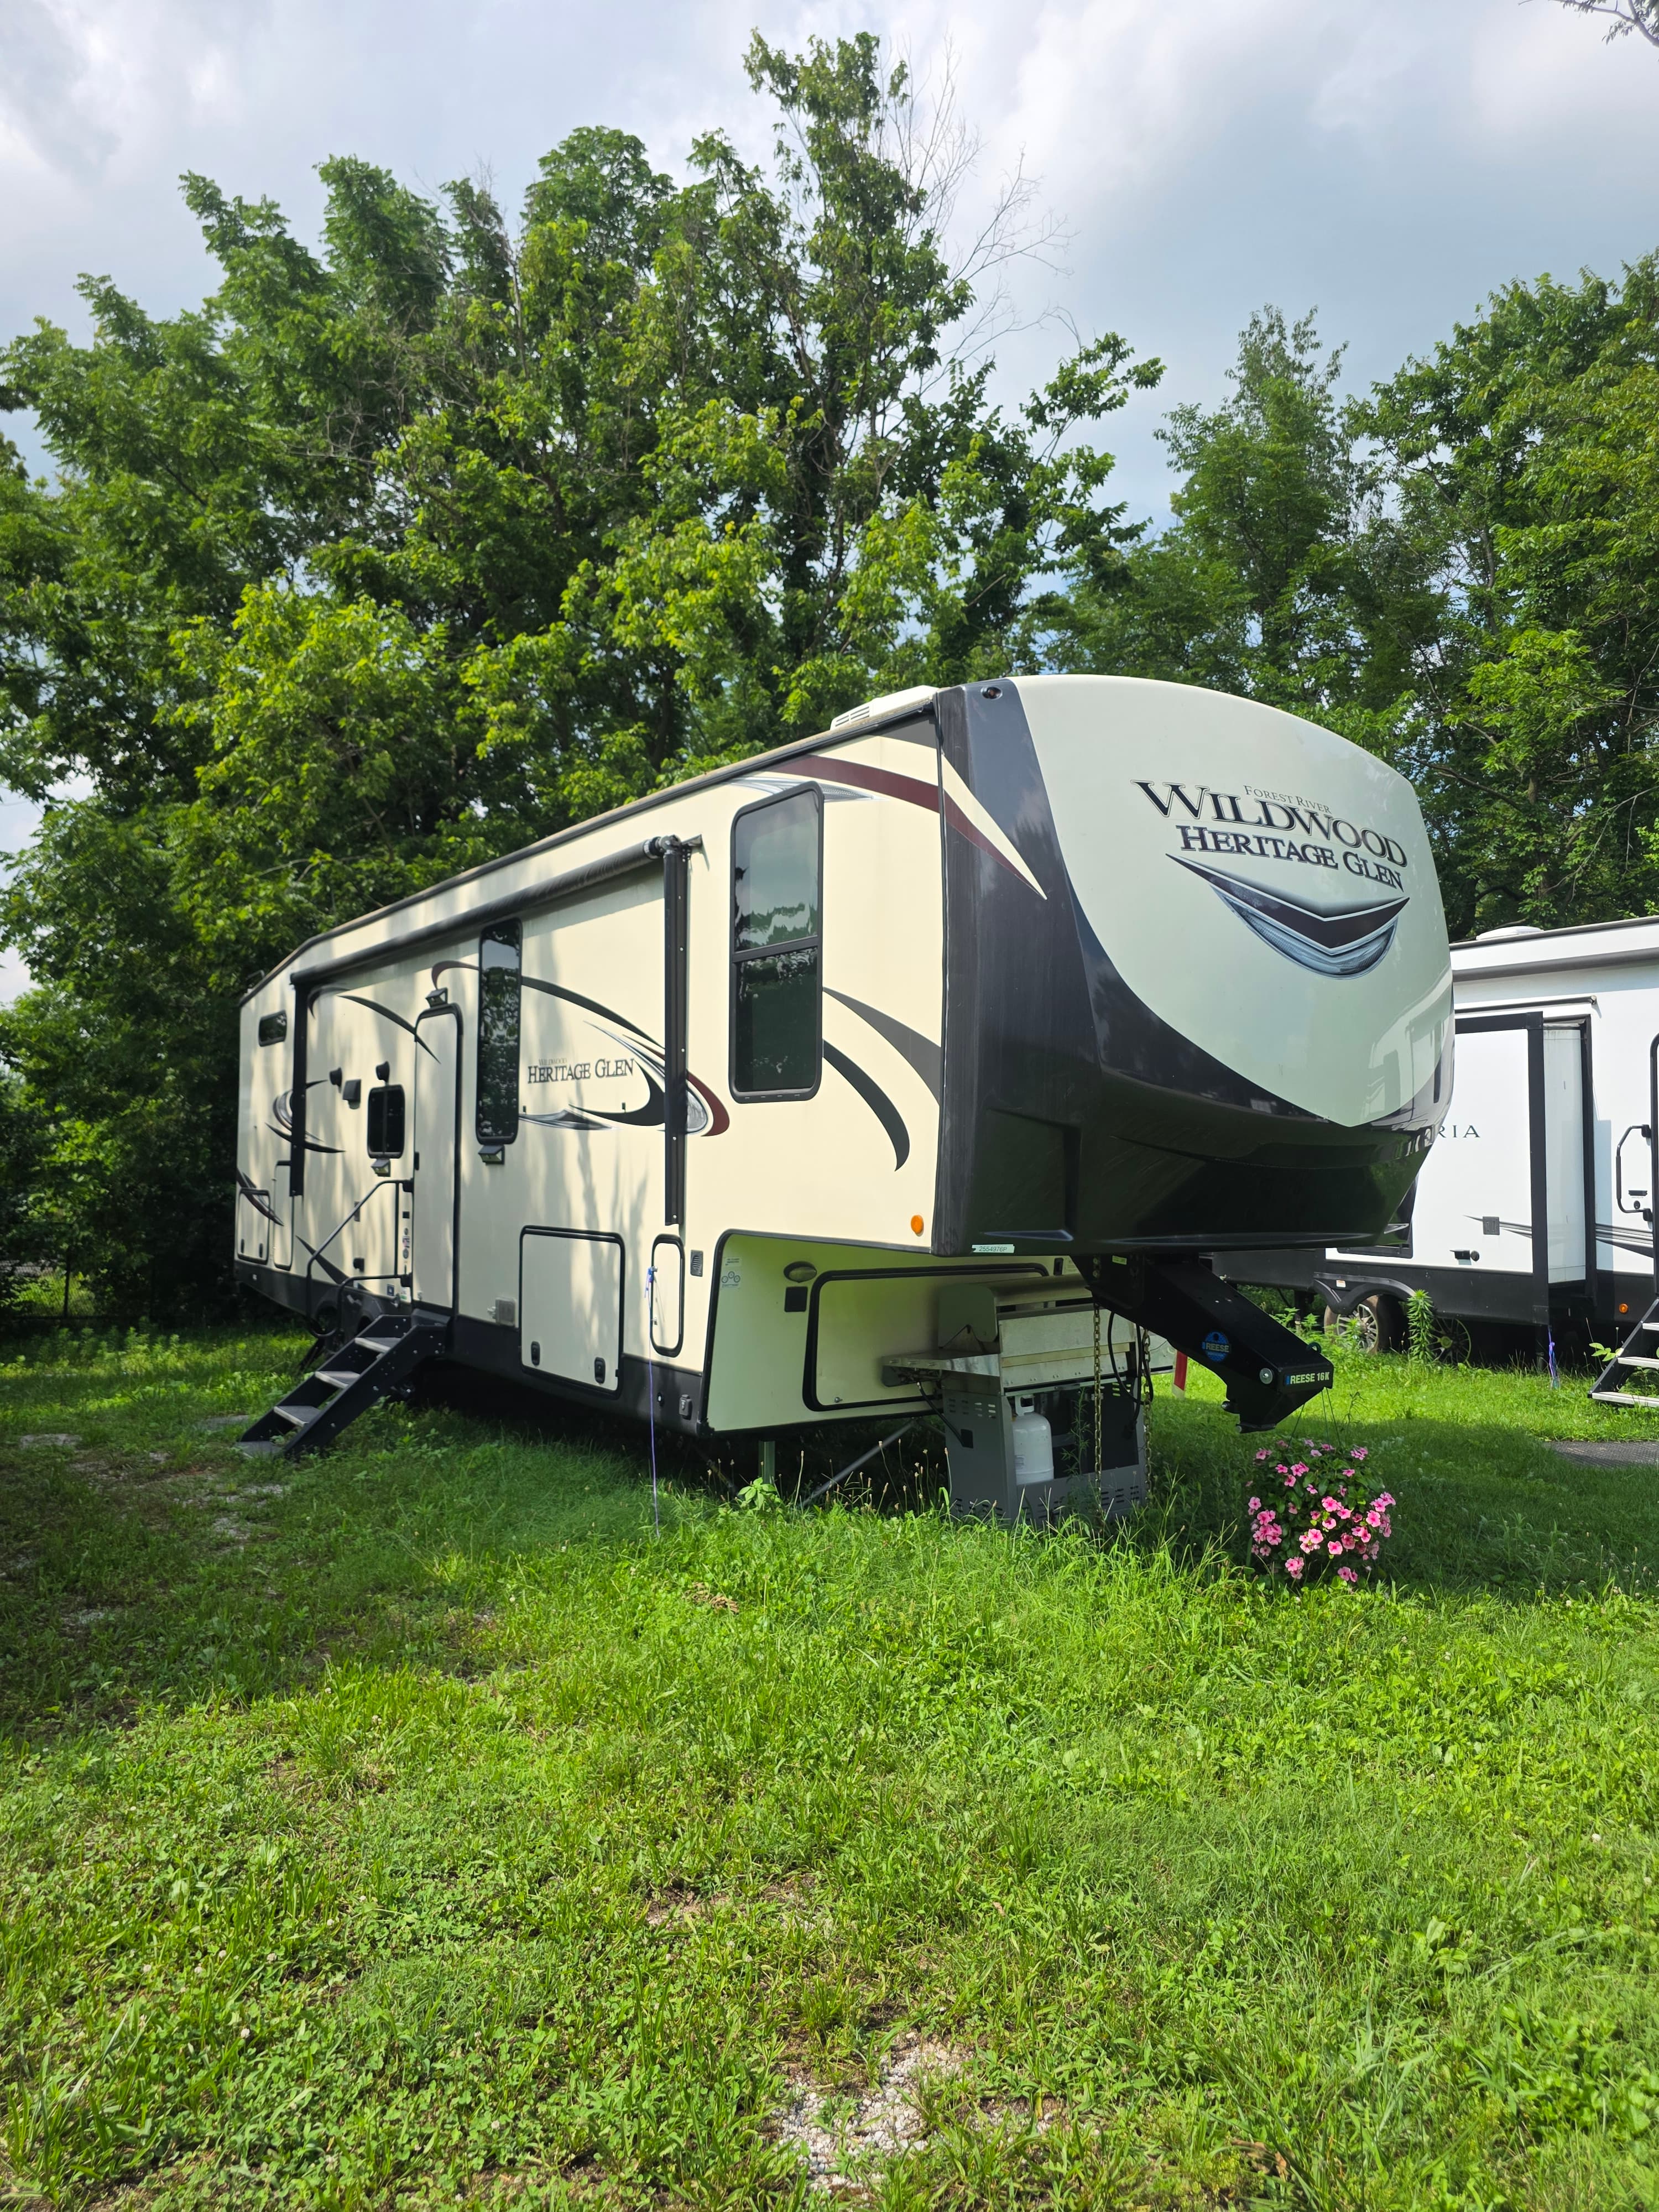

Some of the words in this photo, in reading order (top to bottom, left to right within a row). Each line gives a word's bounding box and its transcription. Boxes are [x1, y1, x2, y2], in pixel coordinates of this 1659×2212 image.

[1243, 785, 1293, 804] FOREST
[1296, 796, 1332, 815] RIVER
[1130, 780, 1408, 868] WILDWOOD
[1176, 825, 1339, 870] HERITAGE
[1342, 851, 1404, 892] GLEN
[528, 1063, 591, 1084] HERITAGE
[595, 1058, 634, 1078] GLEN
[1206, 1343, 1229, 1353] REESE
[1290, 1373, 1316, 1384] REESE
[1317, 1371, 1330, 1381] 16K
